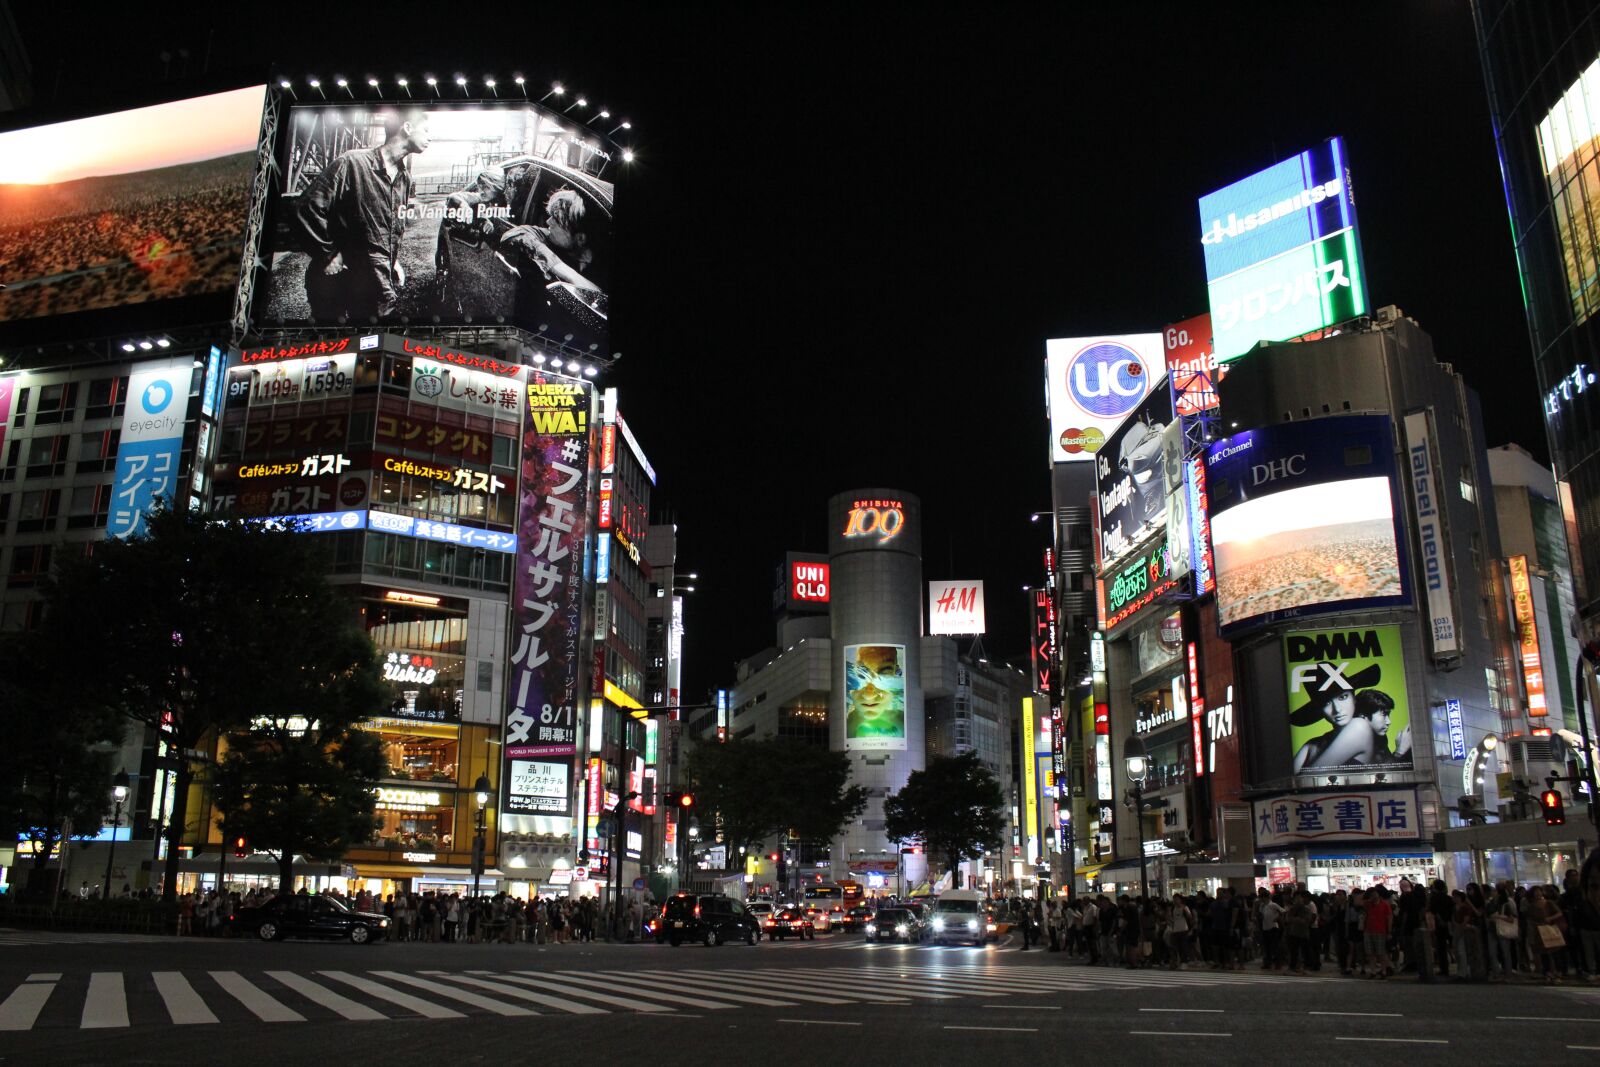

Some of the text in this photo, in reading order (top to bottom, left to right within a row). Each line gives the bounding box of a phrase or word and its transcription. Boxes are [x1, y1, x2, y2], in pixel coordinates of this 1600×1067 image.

[570, 136, 611, 161] HONDA
[419, 203, 473, 223] Vantage
[477, 202, 515, 219] Point.
[1217, 259, 1350, 332] サロンパス
[241, 338, 350, 363] しゃぶしゃぶバイキング
[403, 340, 521, 377] しゃぶしゃぶバイキング
[230, 381, 249, 396] 9F
[450, 376, 518, 410] しゃぶ葉
[528, 384, 584, 396] FUERZA
[529, 395, 576, 407] BRUTA
[130, 416, 178, 434] eyecity
[532, 411, 586, 433] WA!
[377, 416, 488, 456] コンタクト
[1061, 434, 1104, 446] MasterCard
[300, 453, 350, 477] ガスト
[1208, 439, 1252, 466] DHC Channel
[453, 468, 505, 494] ガスト
[1252, 454, 1306, 485] DHC
[214, 495, 236, 511] 7F
[270, 484, 331, 512] ガスト
[854, 500, 903, 508] SHIBUYA
[843, 508, 904, 543] 109
[1410, 437, 1441, 591] Taisei neon
[796, 567, 823, 581] UNI
[797, 583, 825, 598] QLO
[936, 586, 977, 614] H&M
[1287, 630, 1383, 663] DMM
[1291, 662, 1353, 693] FX
[1522, 653, 1546, 709] 三千
[540, 703, 572, 727] 8/1
[1136, 708, 1173, 733] Euphoria
[514, 775, 564, 785] プリンスホテル
[528, 764, 551, 775] 品川
[1260, 799, 1407, 835] 大盛堂書店
[1353, 859, 1373, 867] ONE
[1376, 858, 1411, 867] PIECE
